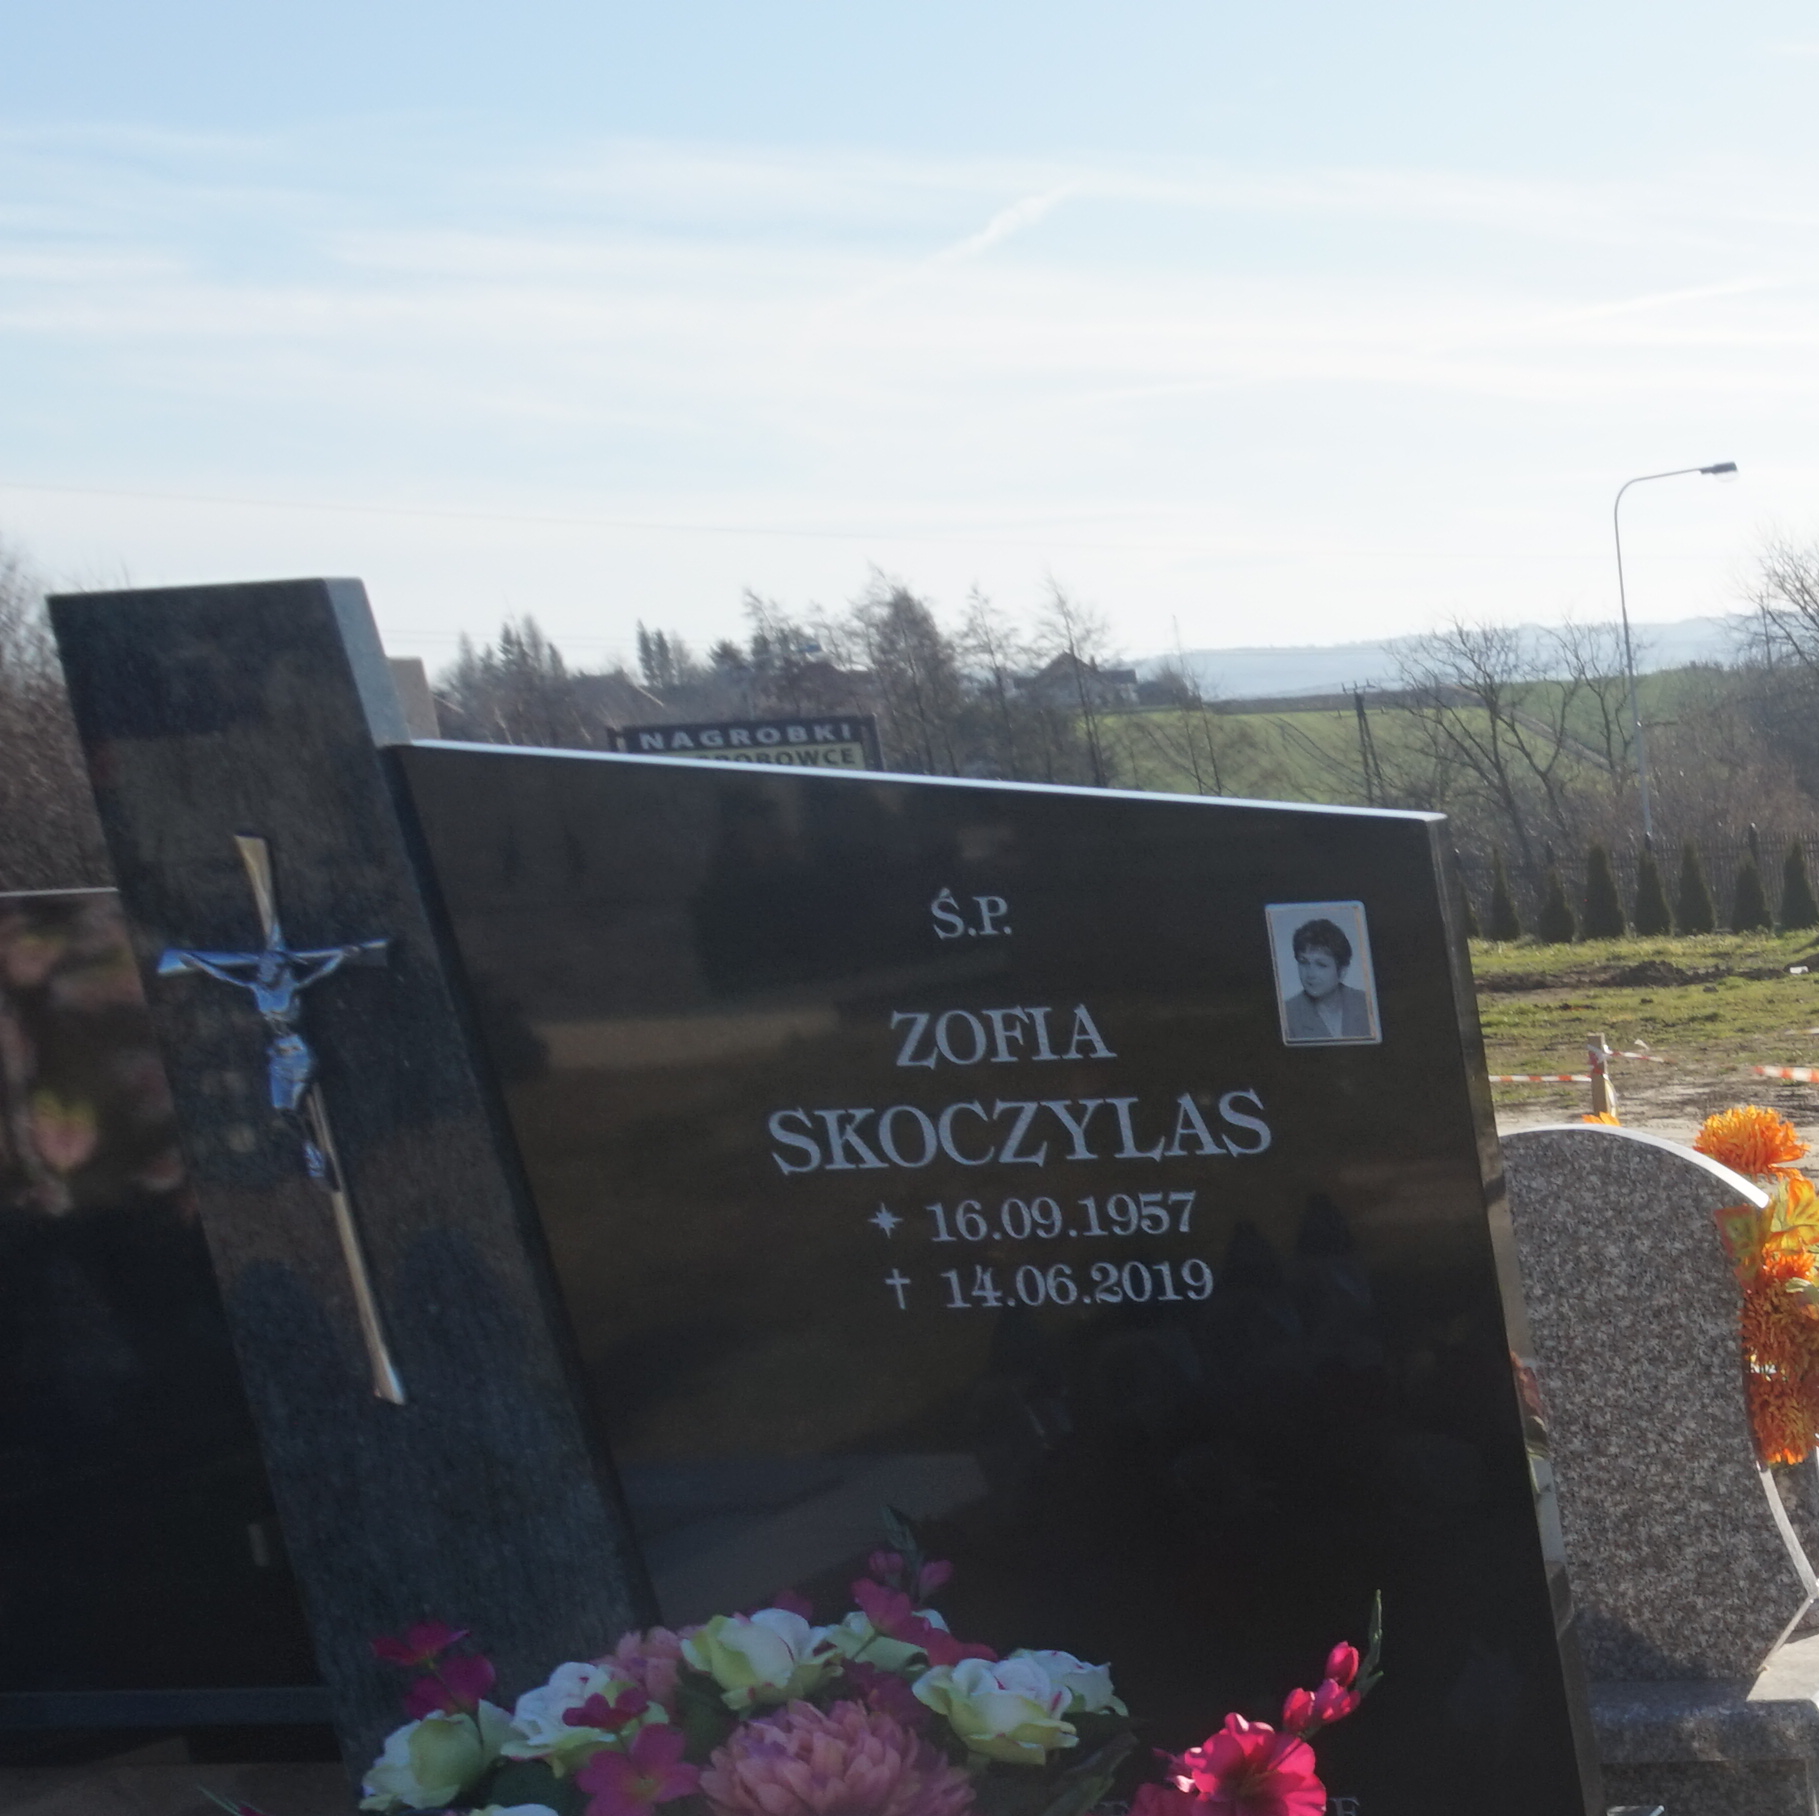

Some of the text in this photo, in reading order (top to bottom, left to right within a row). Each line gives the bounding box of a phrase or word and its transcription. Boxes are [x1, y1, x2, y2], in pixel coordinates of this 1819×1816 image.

[638, 722, 852, 750] NAGROBKI
[930, 886, 1013, 940] Ś.P.
[890, 1003, 1118, 1071] ZOFIA
[768, 1088, 1272, 1176] SKOCZYLAS
[926, 1190, 1196, 1242] 16.09.1957
[941, 1258, 1214, 1309] 14.06.2019
